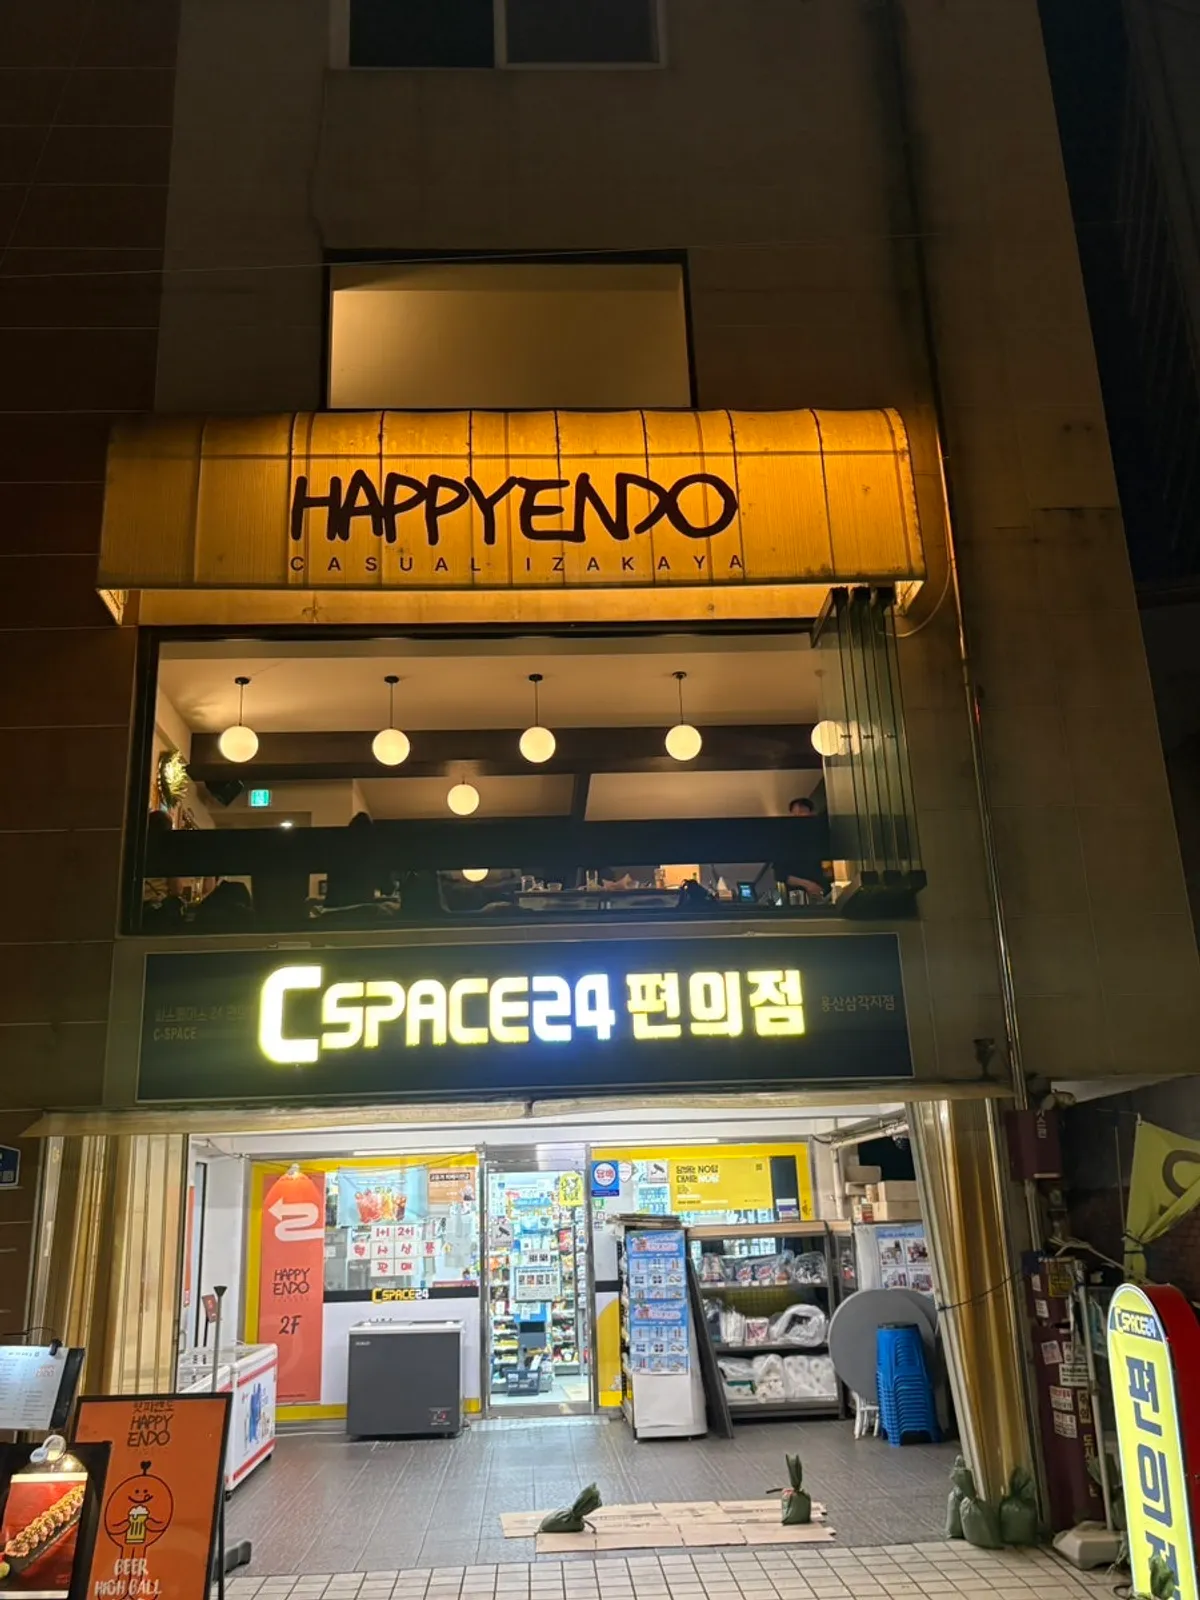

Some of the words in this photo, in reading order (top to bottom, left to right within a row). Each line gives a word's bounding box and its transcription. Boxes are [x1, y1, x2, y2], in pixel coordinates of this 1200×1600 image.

[290, 556, 481, 572] CASUAL
[525, 554, 743, 571] IZAKAYA
[258, 965, 616, 1064] CSPACE24
[625, 969, 806, 1041] 편의점
[153, 1026, 198, 1041] C-SPACE
[376, 1227, 390, 1237] 1+1
[397, 1226, 414, 1237] 2+1
[274, 1268, 311, 1281] HAPPY
[272, 1281, 310, 1296] ENDO
[372, 1288, 430, 1303] CSPACE24
[279, 1315, 302, 1335] 2F
[130, 1414, 174, 1431] HAPPY
[127, 1430, 171, 1447] ENDO
[114, 1558, 149, 1576] BEER
[94, 1579, 126, 1596] HIGH
[128, 1579, 163, 1595] BALL
